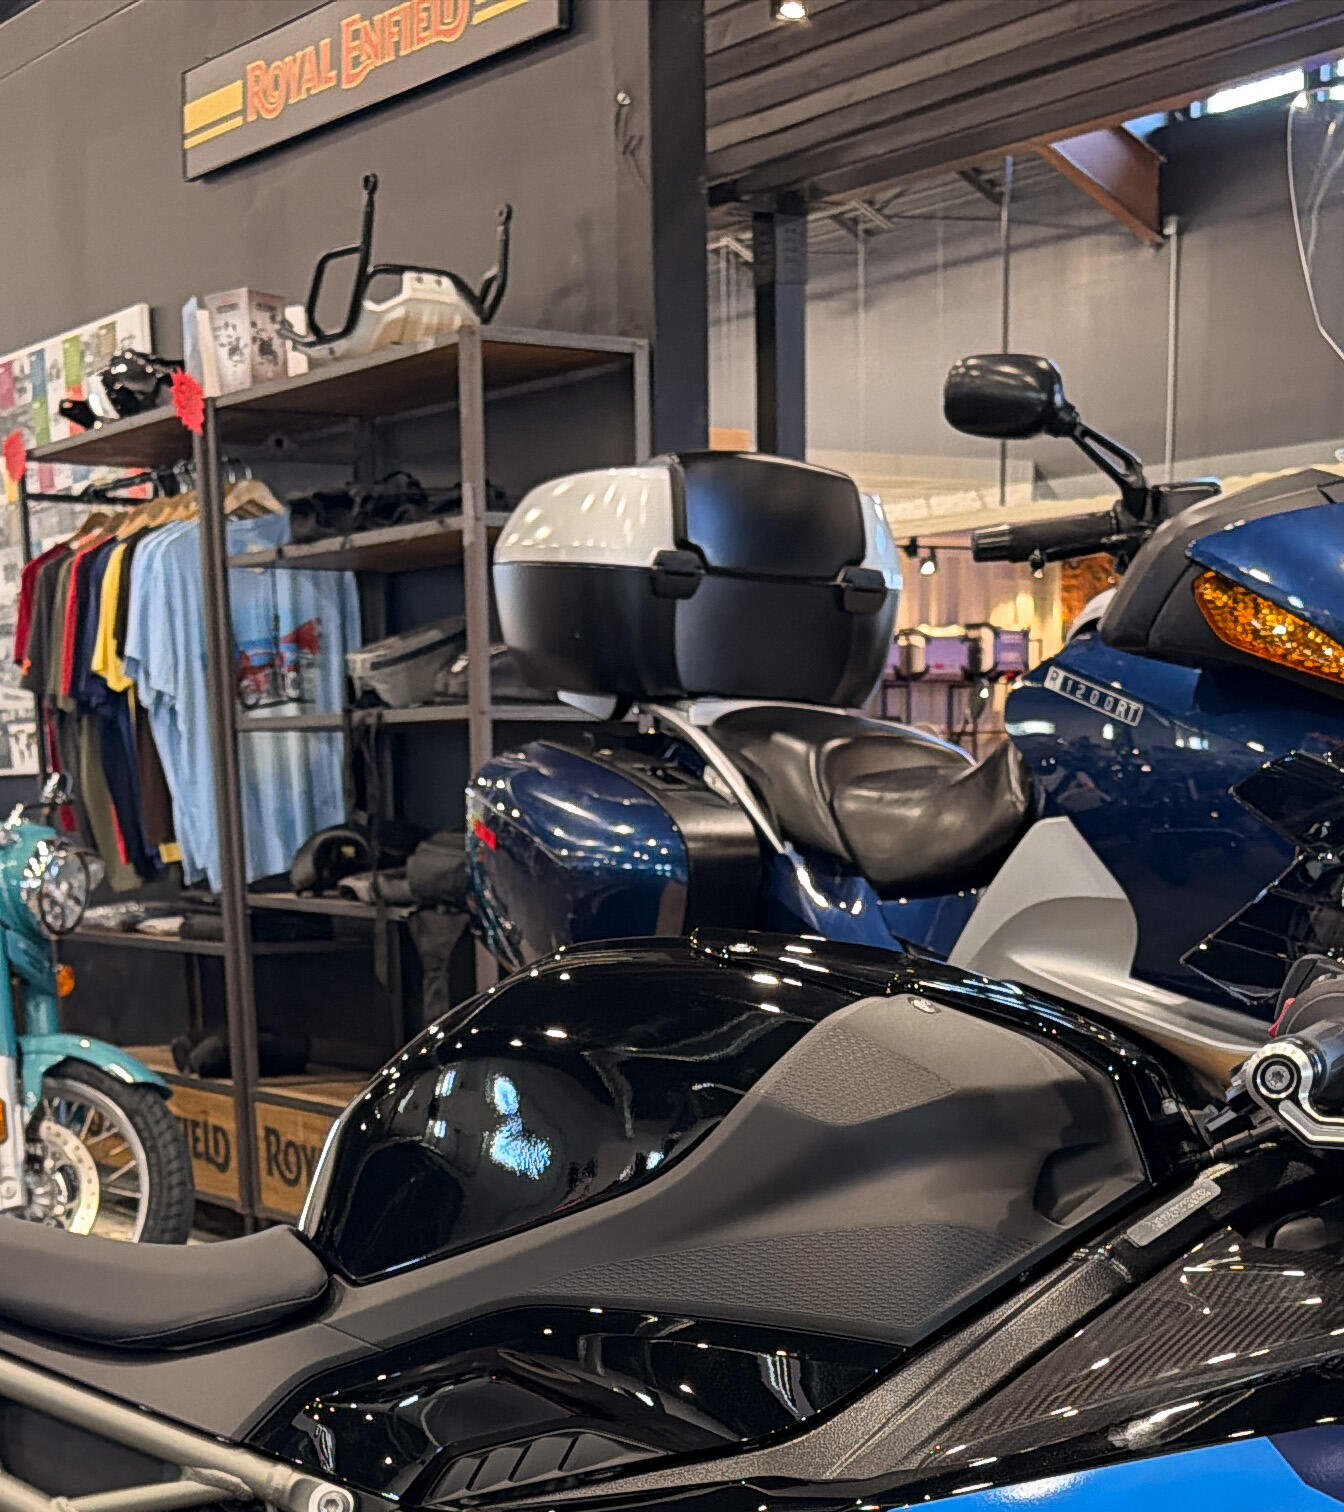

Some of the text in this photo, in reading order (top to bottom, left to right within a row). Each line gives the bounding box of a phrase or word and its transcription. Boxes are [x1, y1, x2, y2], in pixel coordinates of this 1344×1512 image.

[246, 0, 472, 121] ROYAL ENFIELD
[264, 1125, 322, 1187] ROY
